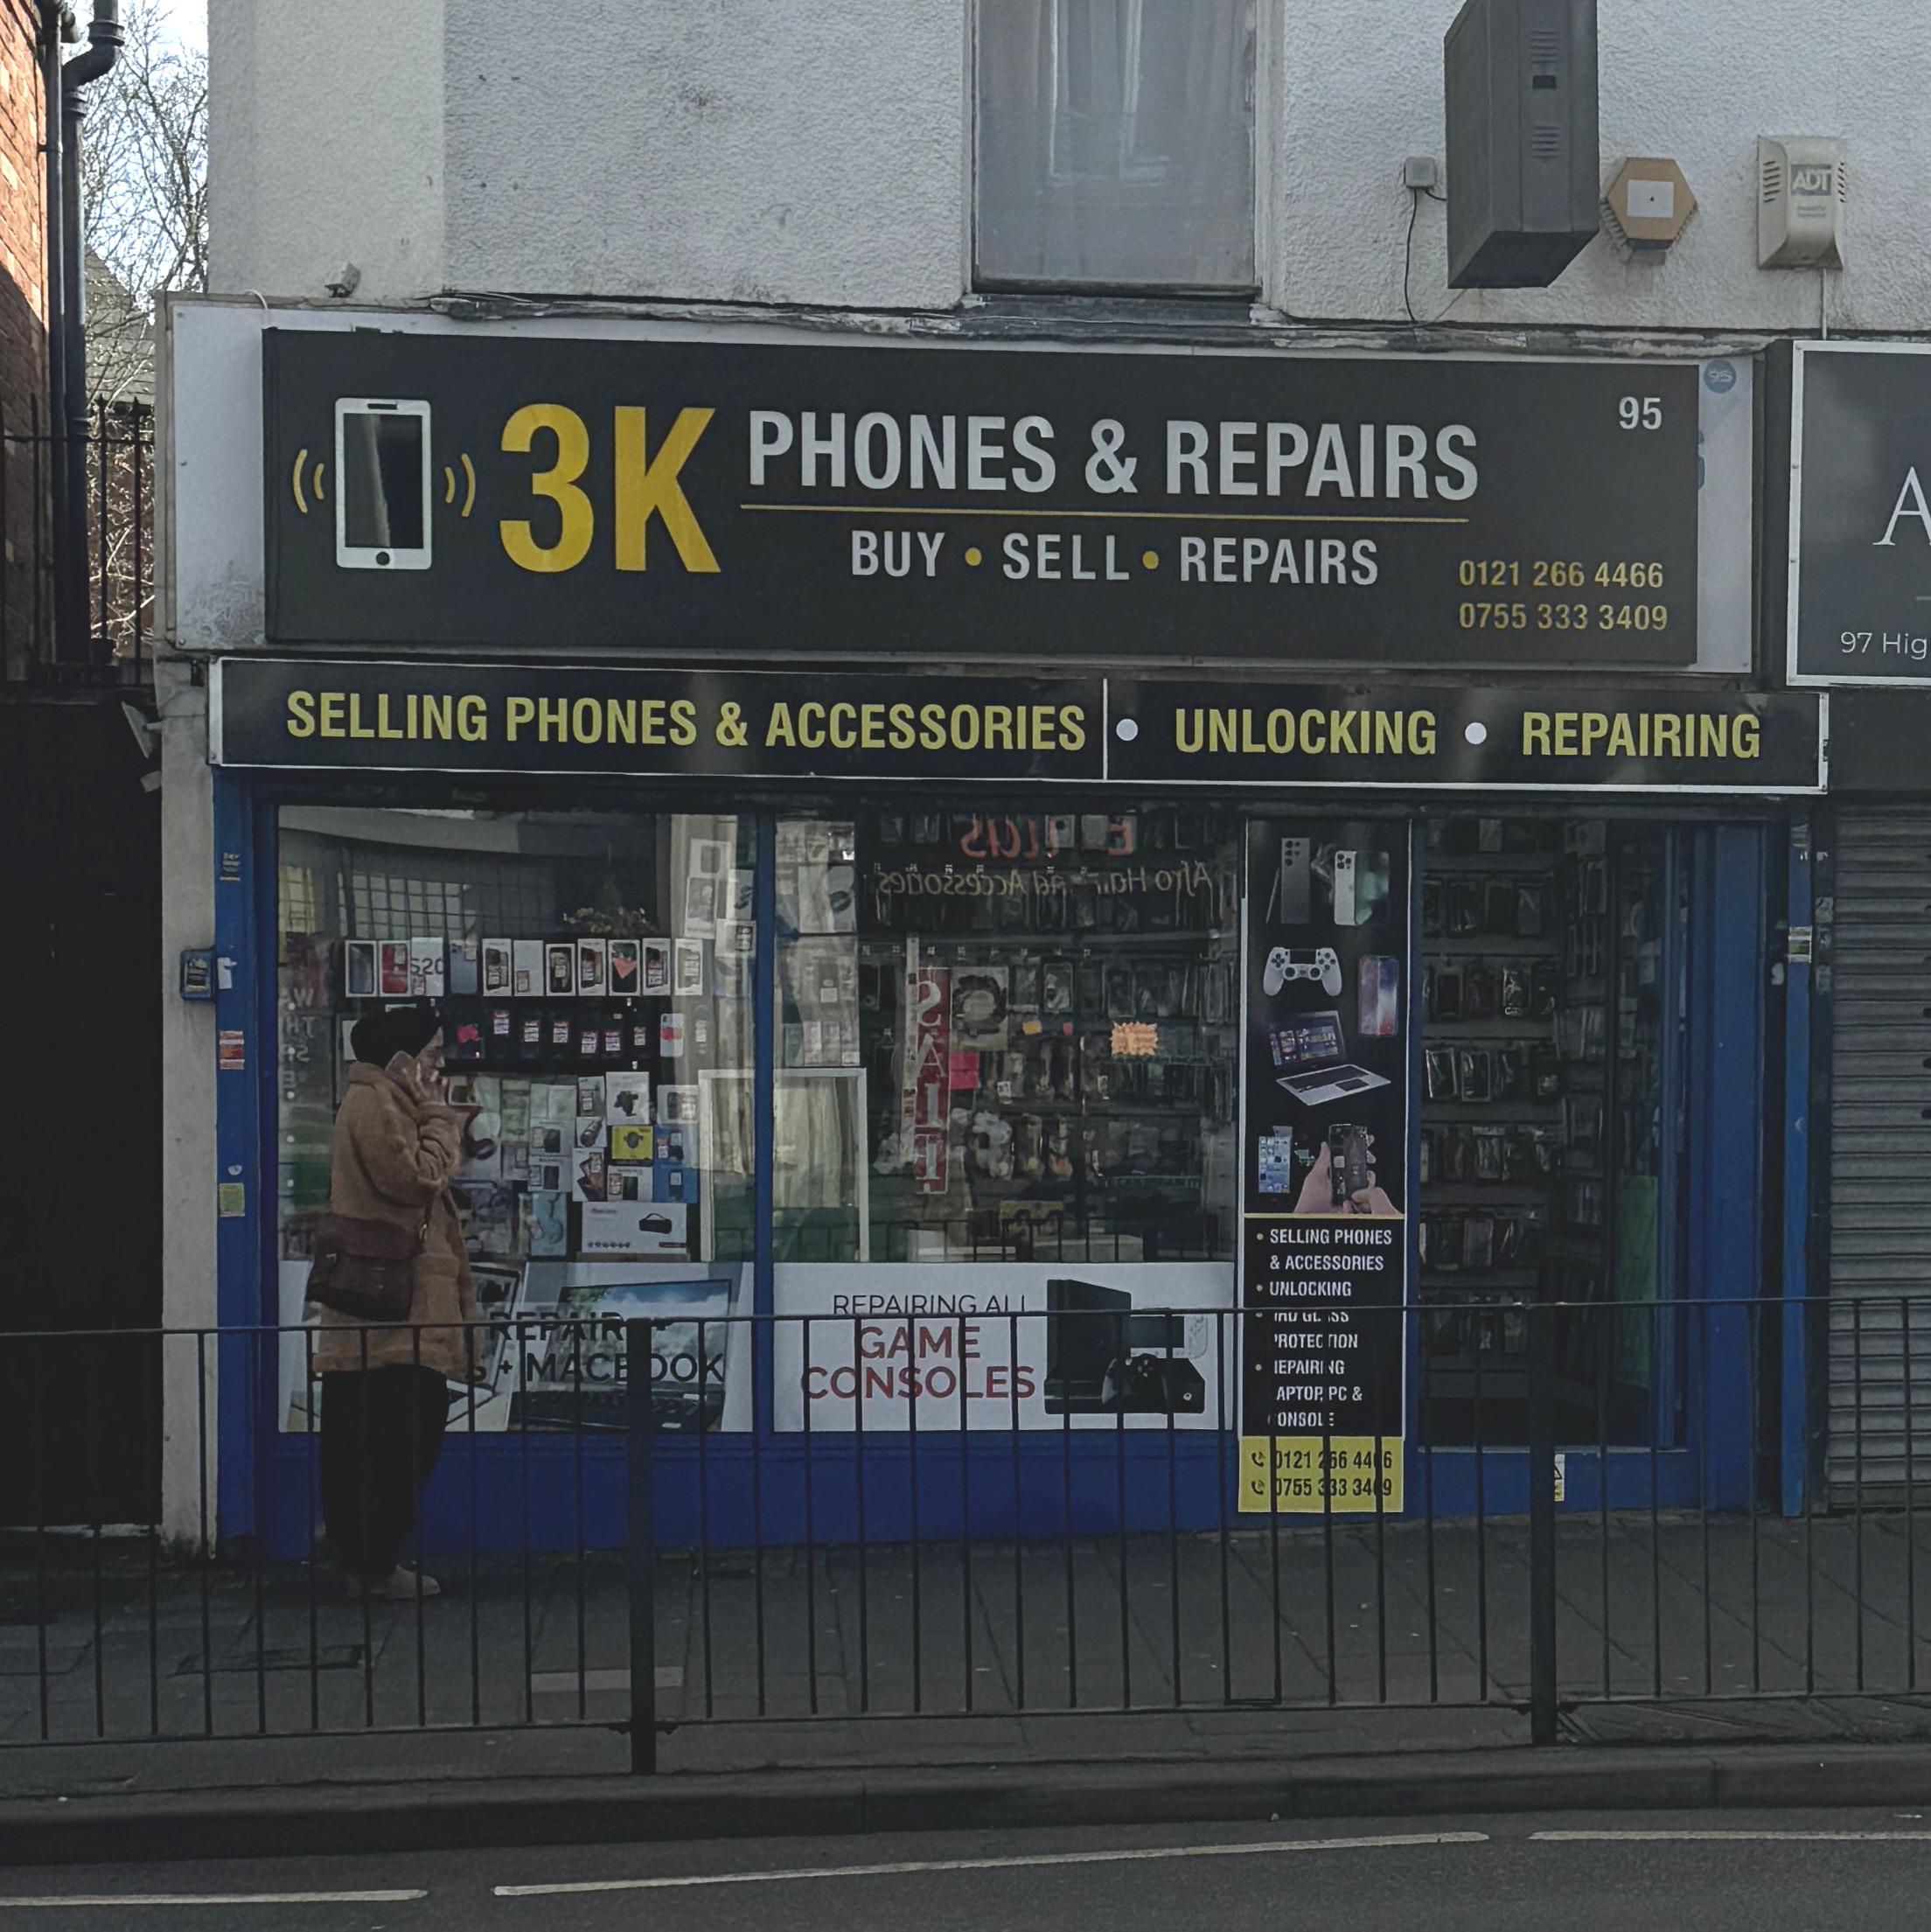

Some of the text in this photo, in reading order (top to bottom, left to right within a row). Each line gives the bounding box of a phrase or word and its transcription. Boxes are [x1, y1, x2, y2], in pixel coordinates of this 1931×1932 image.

[1791, 168, 1831, 192] ADT
[1619, 396, 1663, 430] 95
[749, 410, 1478, 501] PHONES & REPAIRS
[499, 403, 722, 573] 3K
[852, 530, 1378, 586] BUY SELL REPAIRS
[1459, 560, 1663, 589] 0121 266 4466
[1459, 602, 1668, 631] 0755 333 3409
[1841, 631, 1873, 654] 97
[287, 690, 1086, 751] SELLING PHONES & ACCESSORIES
[1175, 708, 1436, 755] UNLOCKING
[1523, 711, 1760, 758] REPAIRING
[1270, 1229, 1392, 1245] SELLING PHONES
[1270, 1255, 1384, 1271] & ACCESSORIES
[1270, 1281, 1352, 1296] UNLOCKING
[1301, 1311, 1349, 1323] GLSS
[858, 1326, 981, 1358] GAME
[1273, 1333, 1358, 1349] ROTECION
[1273, 1385, 1363, 1403] APTOP, PC &
[1268, 1412, 1335, 1427] ONSOLE
[1353, 1450, 1393, 1469] 446
[1353, 1478, 1393, 1496] 349
